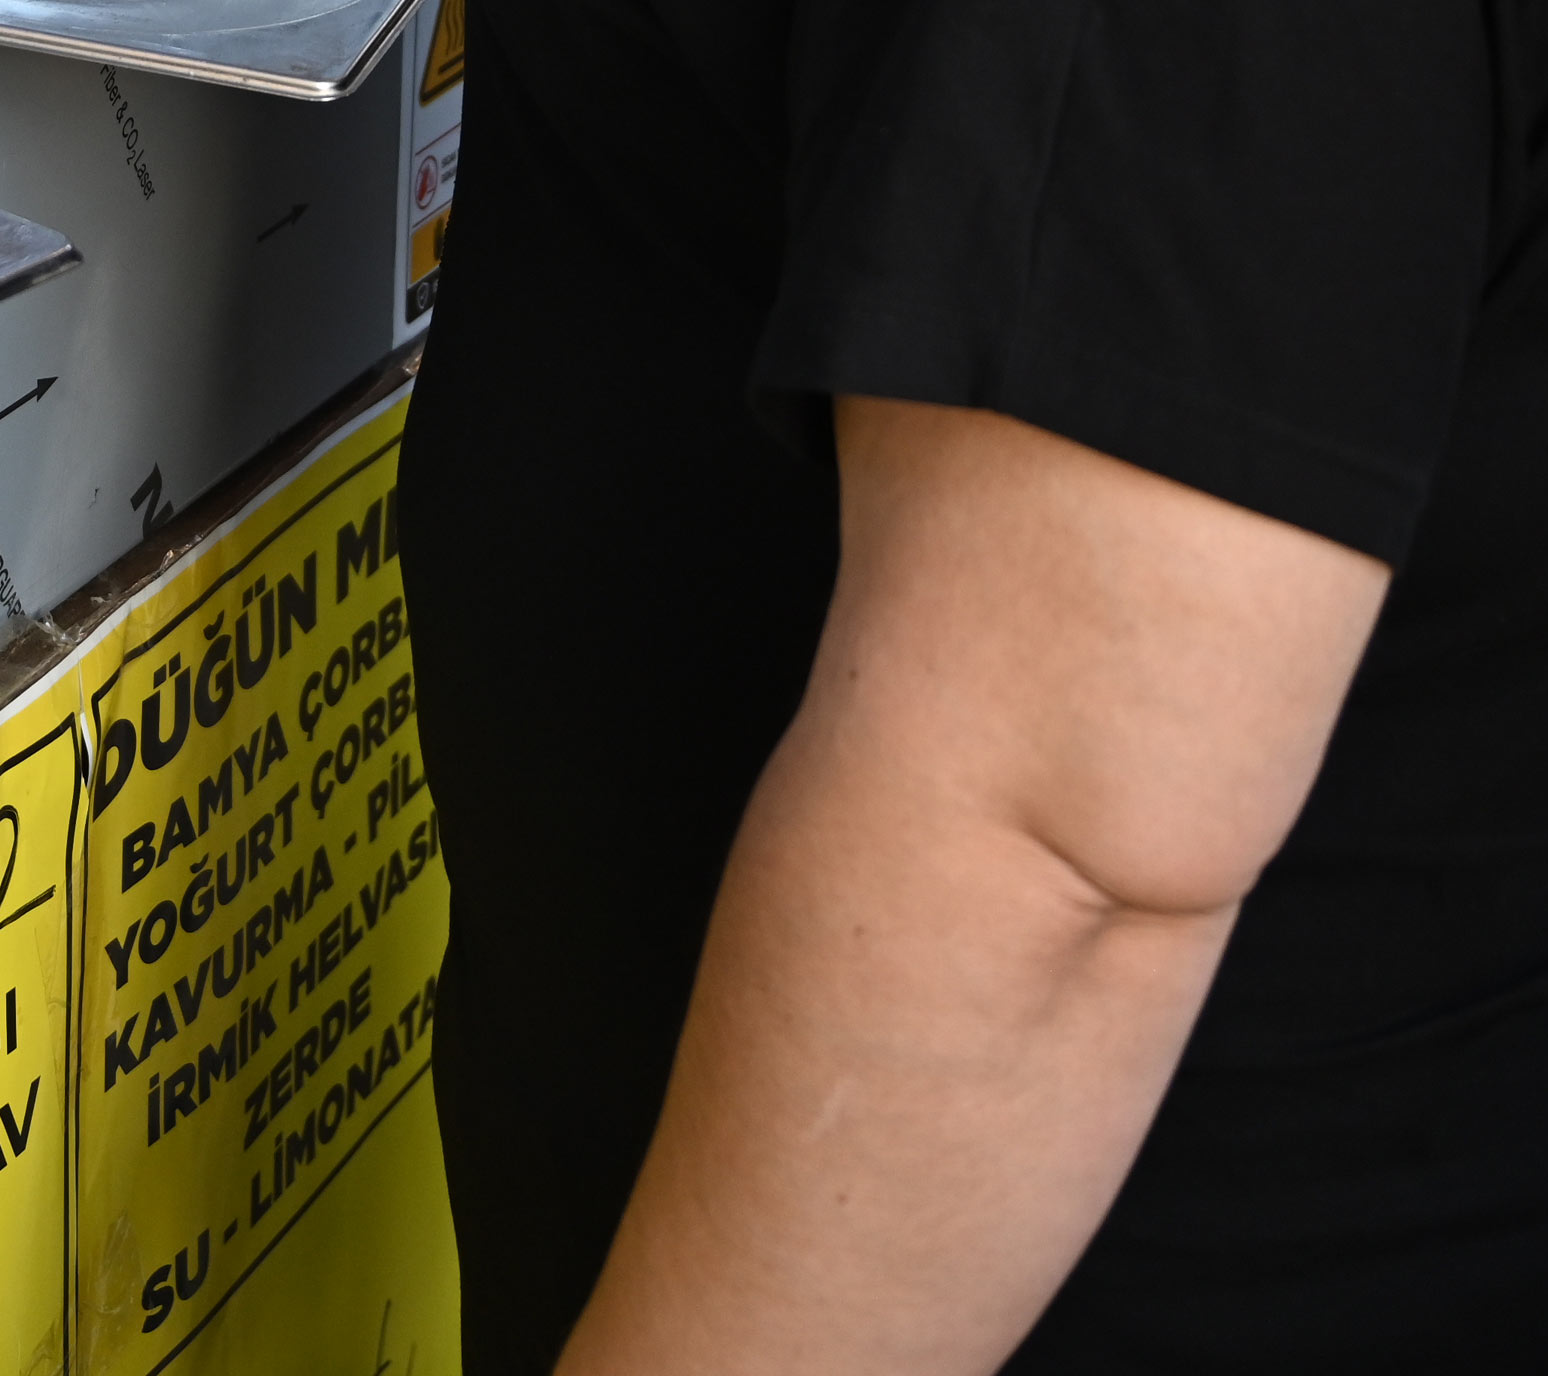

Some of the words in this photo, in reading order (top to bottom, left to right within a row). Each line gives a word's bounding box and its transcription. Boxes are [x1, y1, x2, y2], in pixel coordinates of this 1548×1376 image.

[133, 148, 157, 202] Laser
[92, 550, 317, 824] DÜĞÜN
[121, 710, 289, 894] BAMYA
[298, 595, 411, 742] ÇORB
[104, 780, 300, 992] YOĞURT
[310, 671, 419, 820] ÇORB
[104, 844, 334, 1093] KAVURMA
[146, 978, 279, 1148] İRMİK
[288, 807, 439, 1014] HELVASI
[243, 965, 373, 1151] ZERDE
[140, 1228, 211, 1334] SU
[248, 972, 439, 1230] LİMONATA
